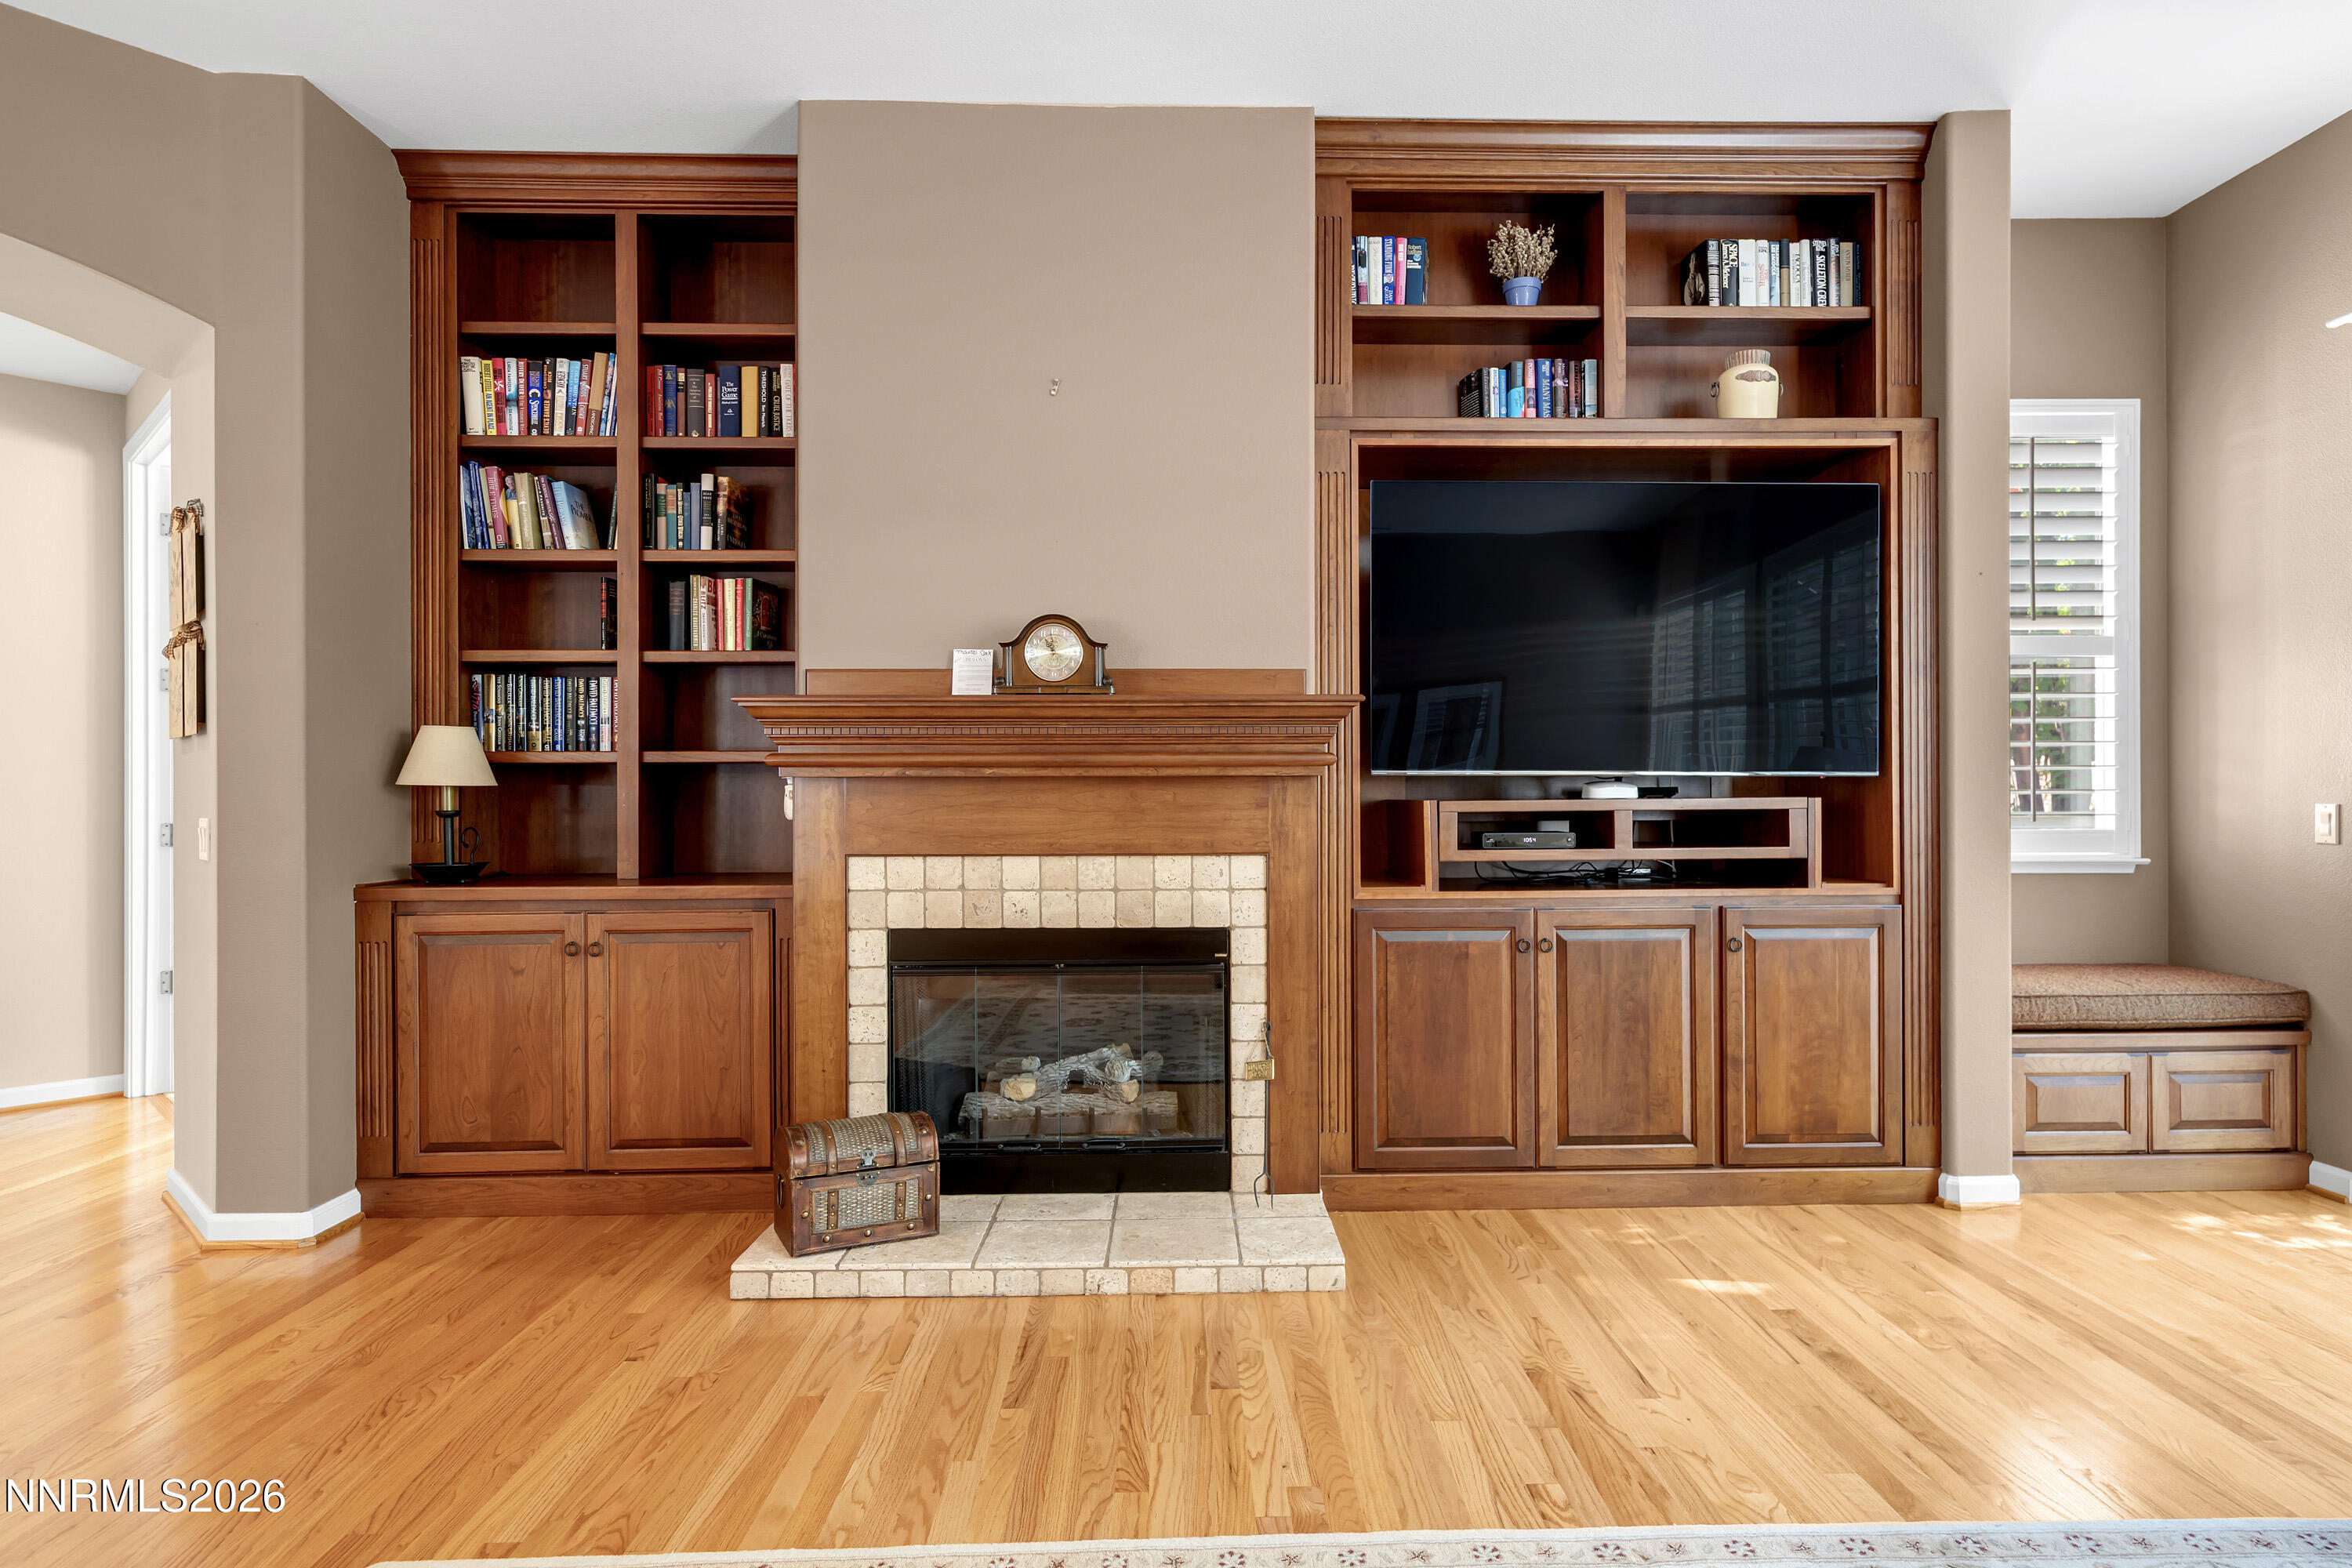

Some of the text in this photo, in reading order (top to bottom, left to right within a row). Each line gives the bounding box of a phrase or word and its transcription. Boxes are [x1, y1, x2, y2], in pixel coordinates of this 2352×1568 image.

[1385, 238, 1393, 274] STANDING FIRM
[1729, 244, 1738, 267] SPACE
[1816, 255, 1826, 289] SKELETON
[488, 477, 496, 496] BIBLE
[489, 497, 499, 518] TIMES
[575, 500, 584, 510] THE
[589, 680, 597, 697] DAVID
[471, 692, 481, 712] 1776
[589, 698, 597, 725] BALDACCI
